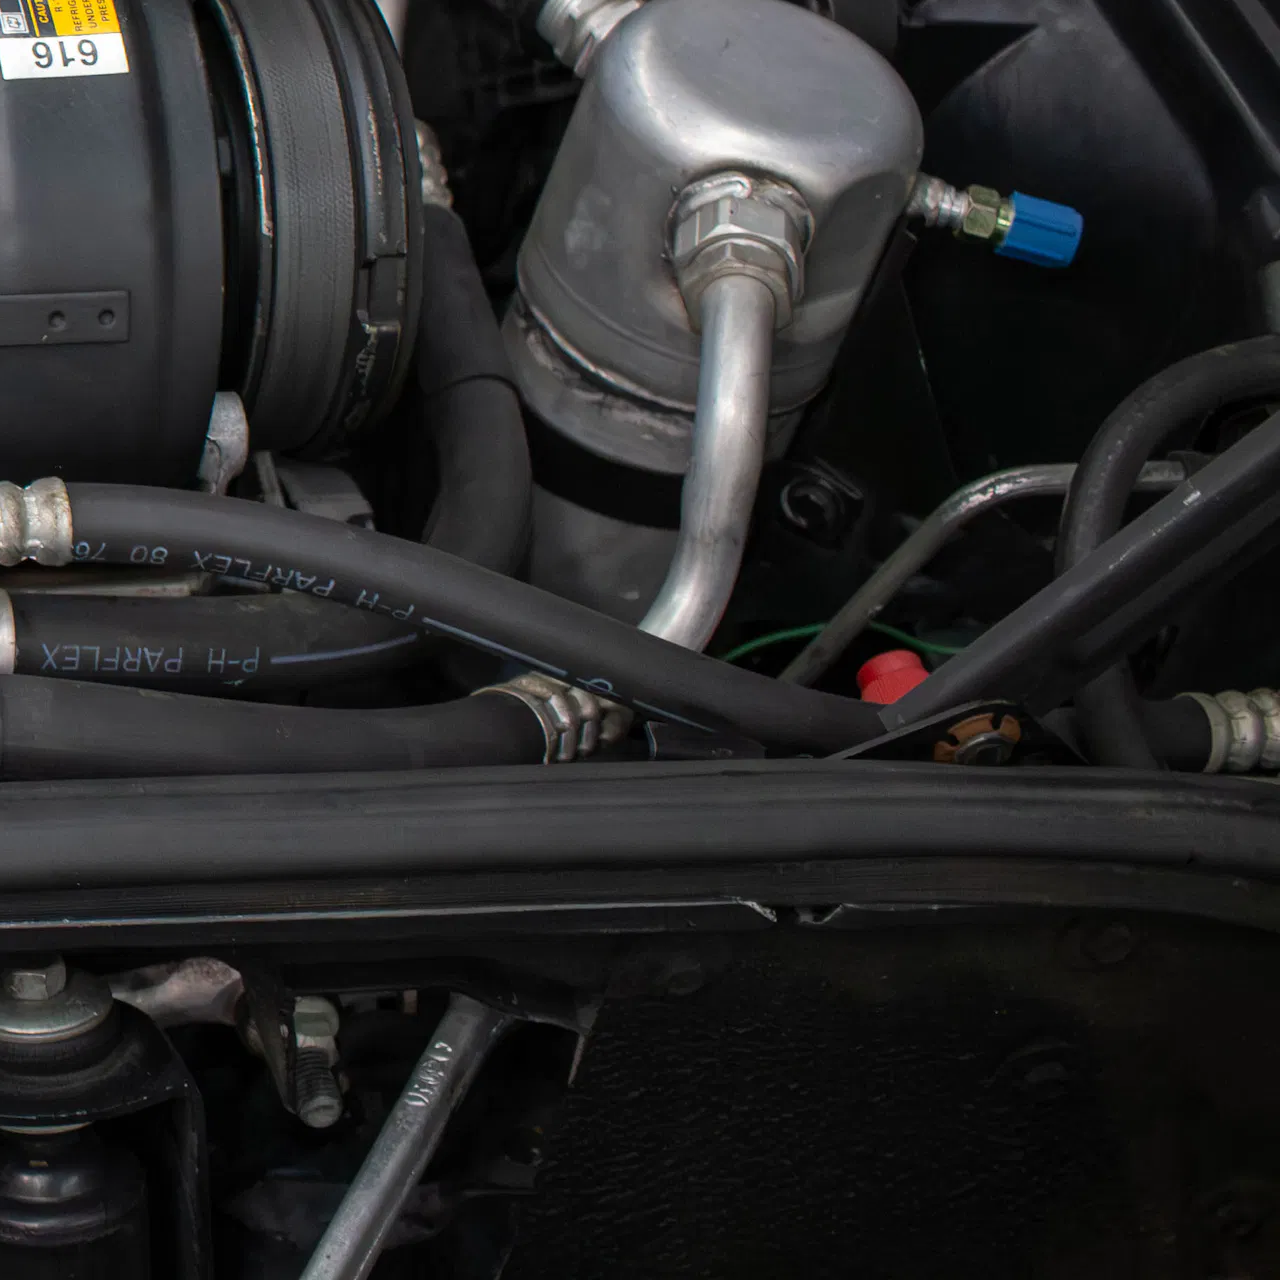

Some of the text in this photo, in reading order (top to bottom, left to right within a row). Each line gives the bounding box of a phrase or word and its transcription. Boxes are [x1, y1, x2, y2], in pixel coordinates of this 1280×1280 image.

[32, 39, 98, 69] 616
[130, 544, 169, 564] 80
[193, 549, 337, 598] PARFLEX
[356, 588, 415, 620] P-H
[41, 642, 260, 674] P-H PARFLEX
